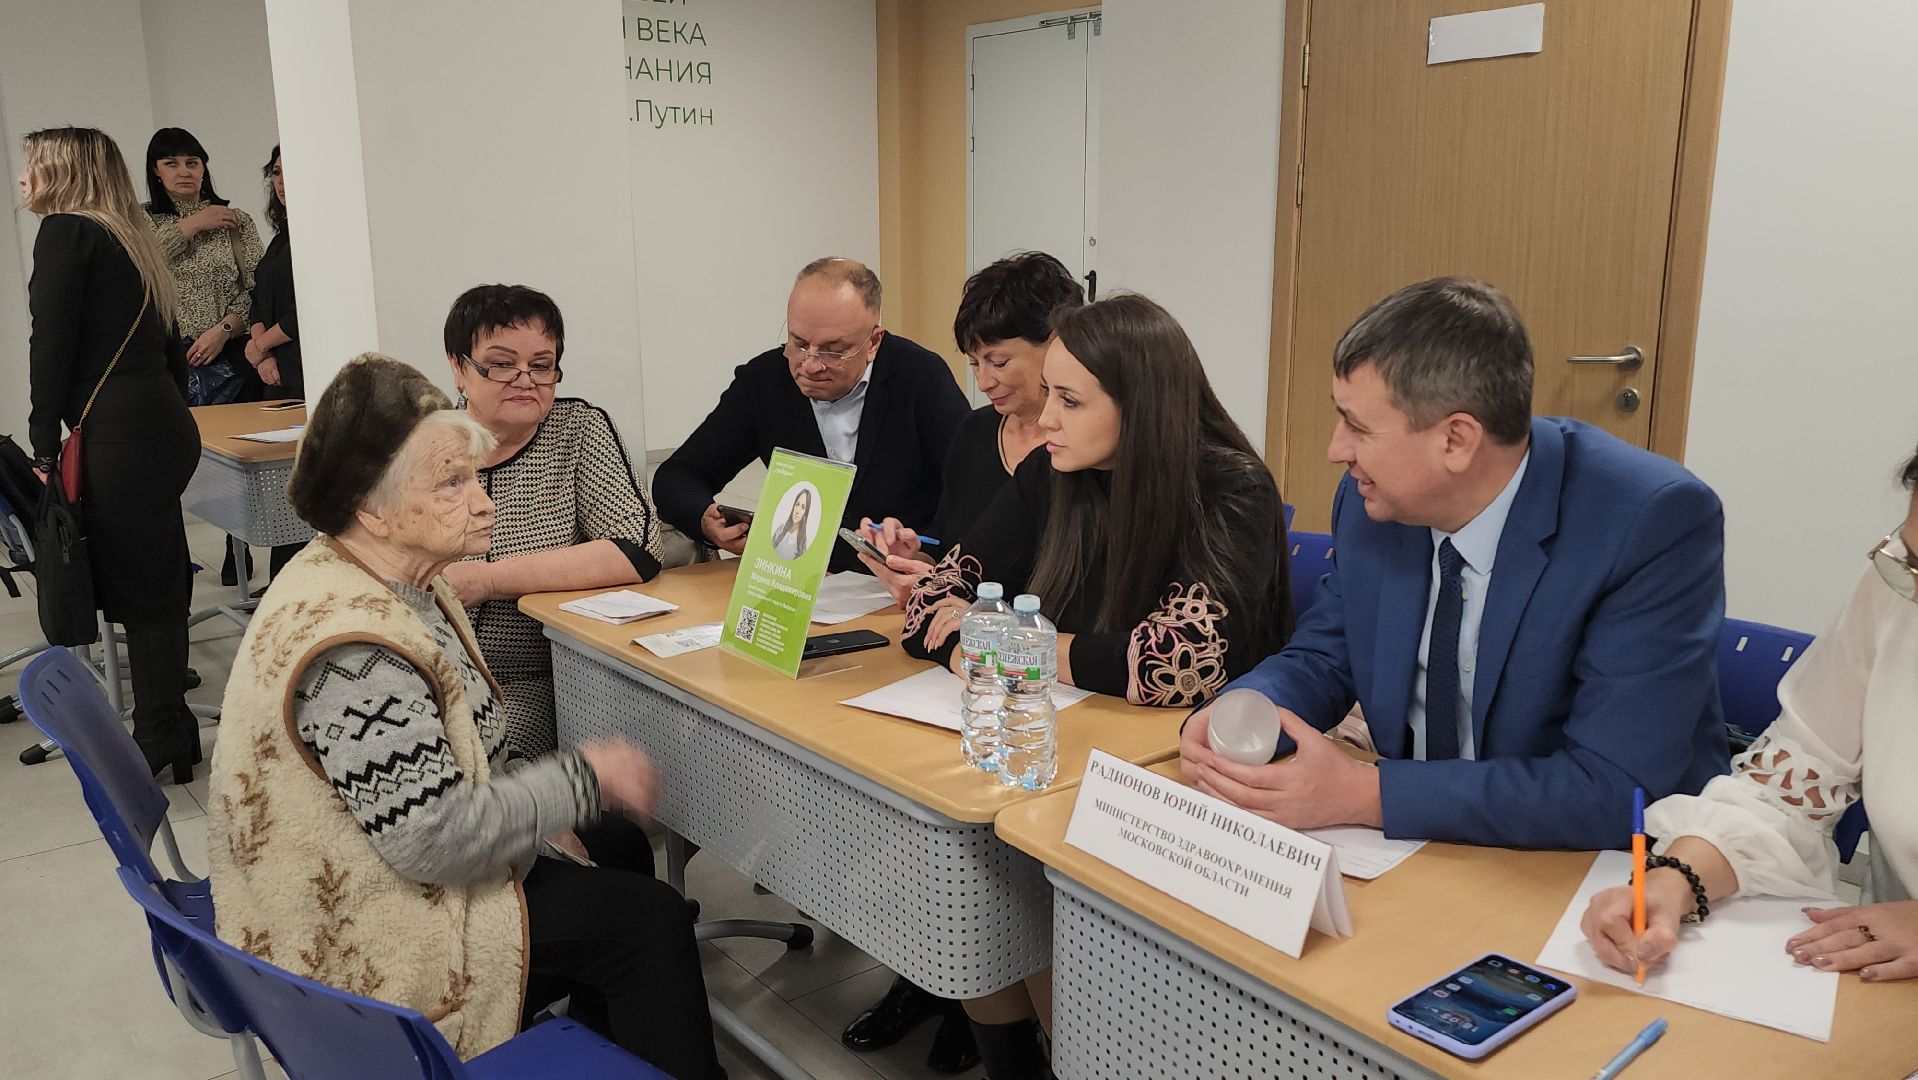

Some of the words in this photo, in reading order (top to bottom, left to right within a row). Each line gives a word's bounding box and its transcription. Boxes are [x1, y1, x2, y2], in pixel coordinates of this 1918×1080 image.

[637, 17, 707, 47] ВЕКА
[754, 557, 792, 581] ЗИНКИНА
[1090, 760, 1161, 801] РАДИОНОВ
[1163, 792, 1208, 821] ЮРИЙ
[1210, 812, 1322, 871] НИКОЛАЕВИЧ
[1093, 798, 1176, 844] МИНИСТЕРСТВО
[1178, 837, 1293, 899] ЗДРАВООХРАНЕНИЯ
[1118, 827, 1193, 870] МОСКОВСКОЙ
[1194, 863, 1250, 897] ОБЛАСТИ
